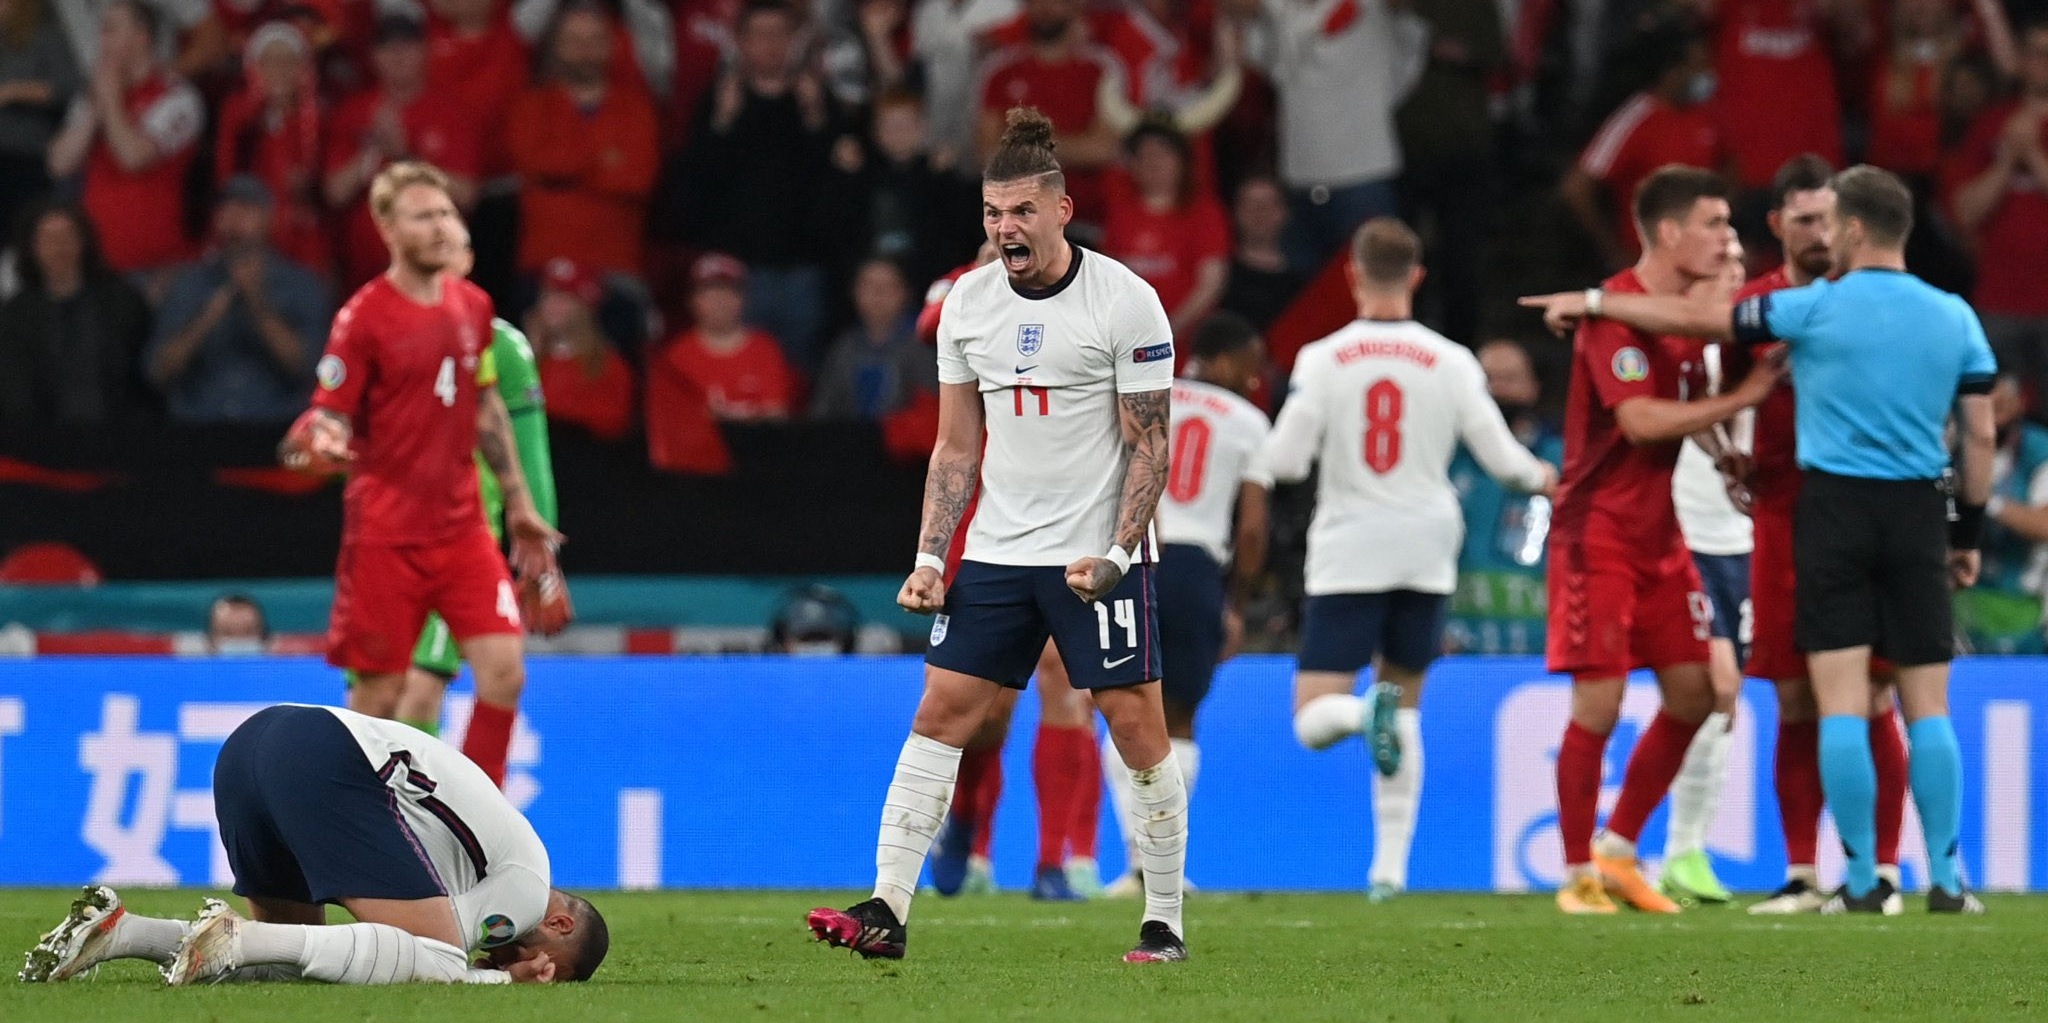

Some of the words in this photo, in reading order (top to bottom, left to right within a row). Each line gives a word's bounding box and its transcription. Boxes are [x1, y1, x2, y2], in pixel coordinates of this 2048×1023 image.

[434, 355, 457, 407] 4
[1365, 378, 1402, 474] 8
[496, 578, 520, 627] 4
[1093, 598, 1138, 650] 14
